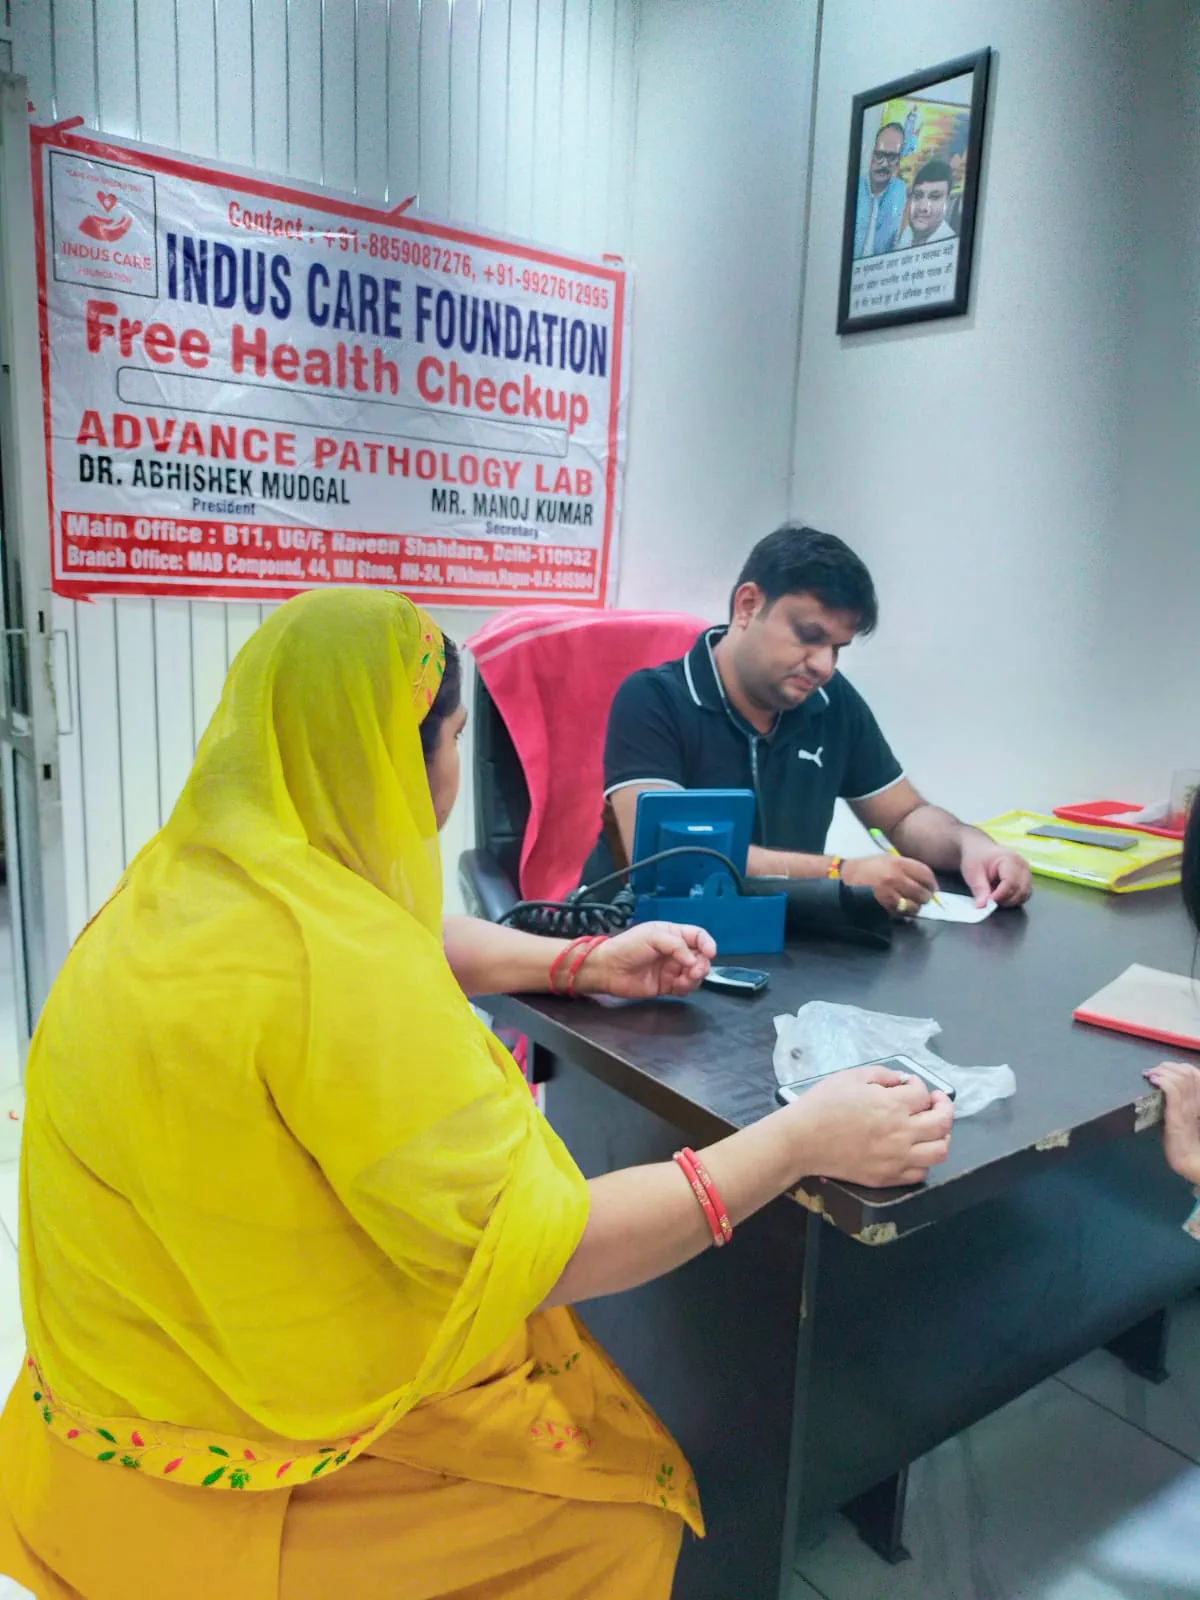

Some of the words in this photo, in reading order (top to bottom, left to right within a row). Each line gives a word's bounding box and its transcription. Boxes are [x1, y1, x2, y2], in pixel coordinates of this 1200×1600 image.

[61, 241, 110, 262] INDUS
[112, 251, 152, 271] CARE
[228, 201, 302, 239] Contact
[323, 226, 477, 281] +91-8859087276,
[483, 263, 609, 309] +91-9927612995
[166, 233, 292, 320] INDUS
[307, 262, 402, 340] CARE
[415, 284, 607, 378] FOUNDATION
[86, 299, 211, 369] Free
[231, 323, 398, 395] Health
[416, 355, 589, 435] Checkup
[76, 409, 297, 467] ADVANCE
[313, 437, 522, 490] PATHOLOGY
[535, 463, 593, 497] LAB
[79, 453, 122, 486] DR.
[132, 459, 253, 497] ABHISHEK
[262, 471, 351, 505] MUDGAL
[192, 497, 256, 516] President
[431, 488, 466, 516] MR.
[473, 492, 529, 521] MANOJ
[536, 498, 593, 526] KUMAR
[66, 514, 127, 539] Main
[134, 518, 203, 544] Office
[223, 524, 272, 551] B11,
[277, 527, 327, 554] UG/F,
[332, 532, 400, 555] Naveen
[485, 520, 539, 540] Secretary
[66, 544, 126, 568] Branch
[130, 548, 184, 571] Office:
